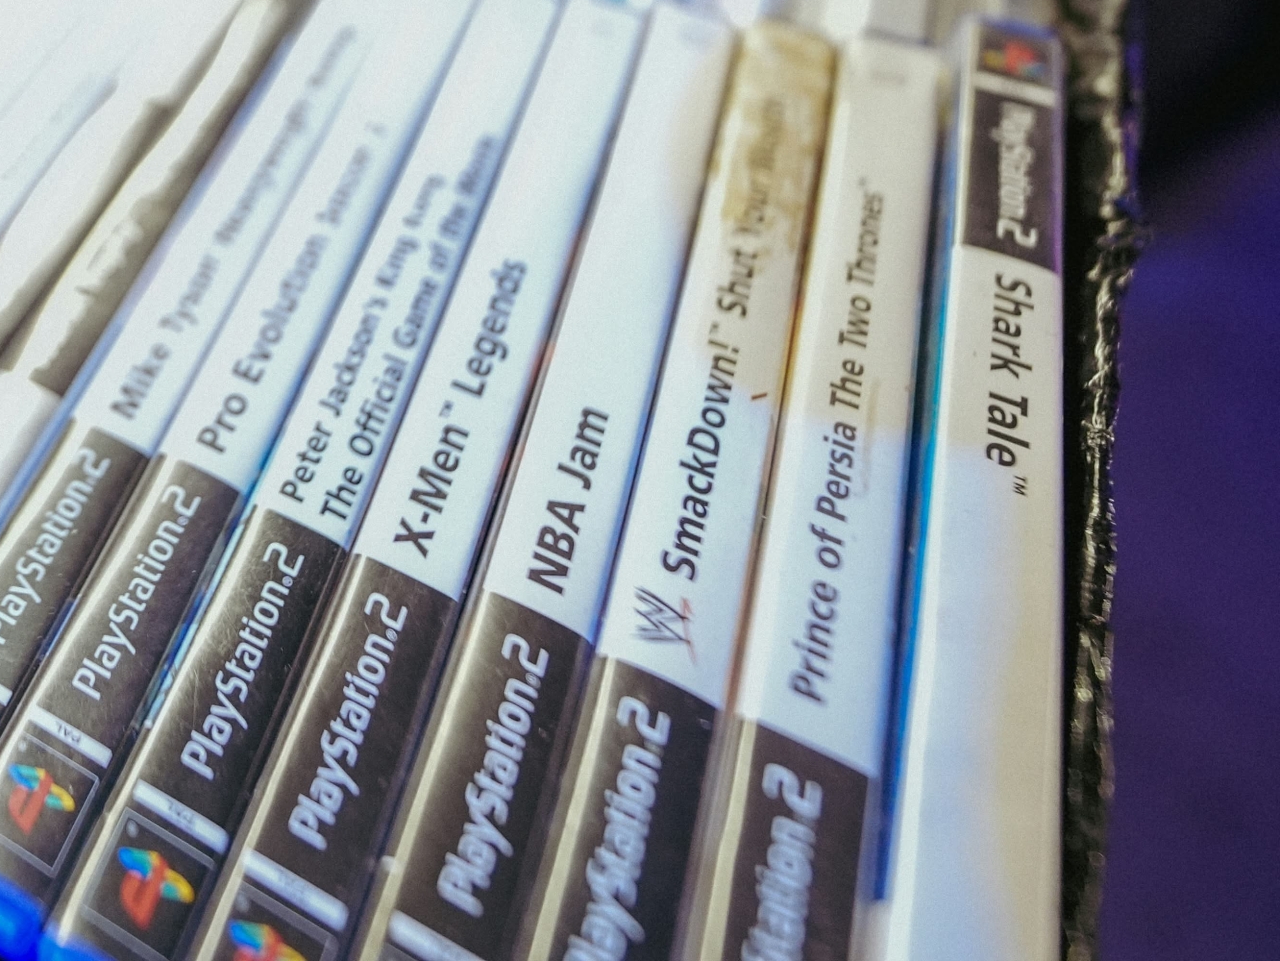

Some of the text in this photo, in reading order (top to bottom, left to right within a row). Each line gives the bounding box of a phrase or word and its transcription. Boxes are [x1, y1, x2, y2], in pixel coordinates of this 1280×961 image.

[451, 258, 527, 400] Legends
[717, 246, 758, 319] Shut
[837, 294, 872, 349] Two
[990, 273, 1035, 379] Shark
[196, 392, 248, 454] Pro
[233, 233, 330, 386] Evolution
[829, 358, 864, 410] The
[279, 421, 334, 505] Peter
[320, 466, 365, 525] The
[348, 351, 410, 461] Official
[815, 420, 857, 523] Persia
[526, 406, 609, 596] NBA Jam
[809, 522, 844, 570] of
[789, 579, 838, 705] Prince
